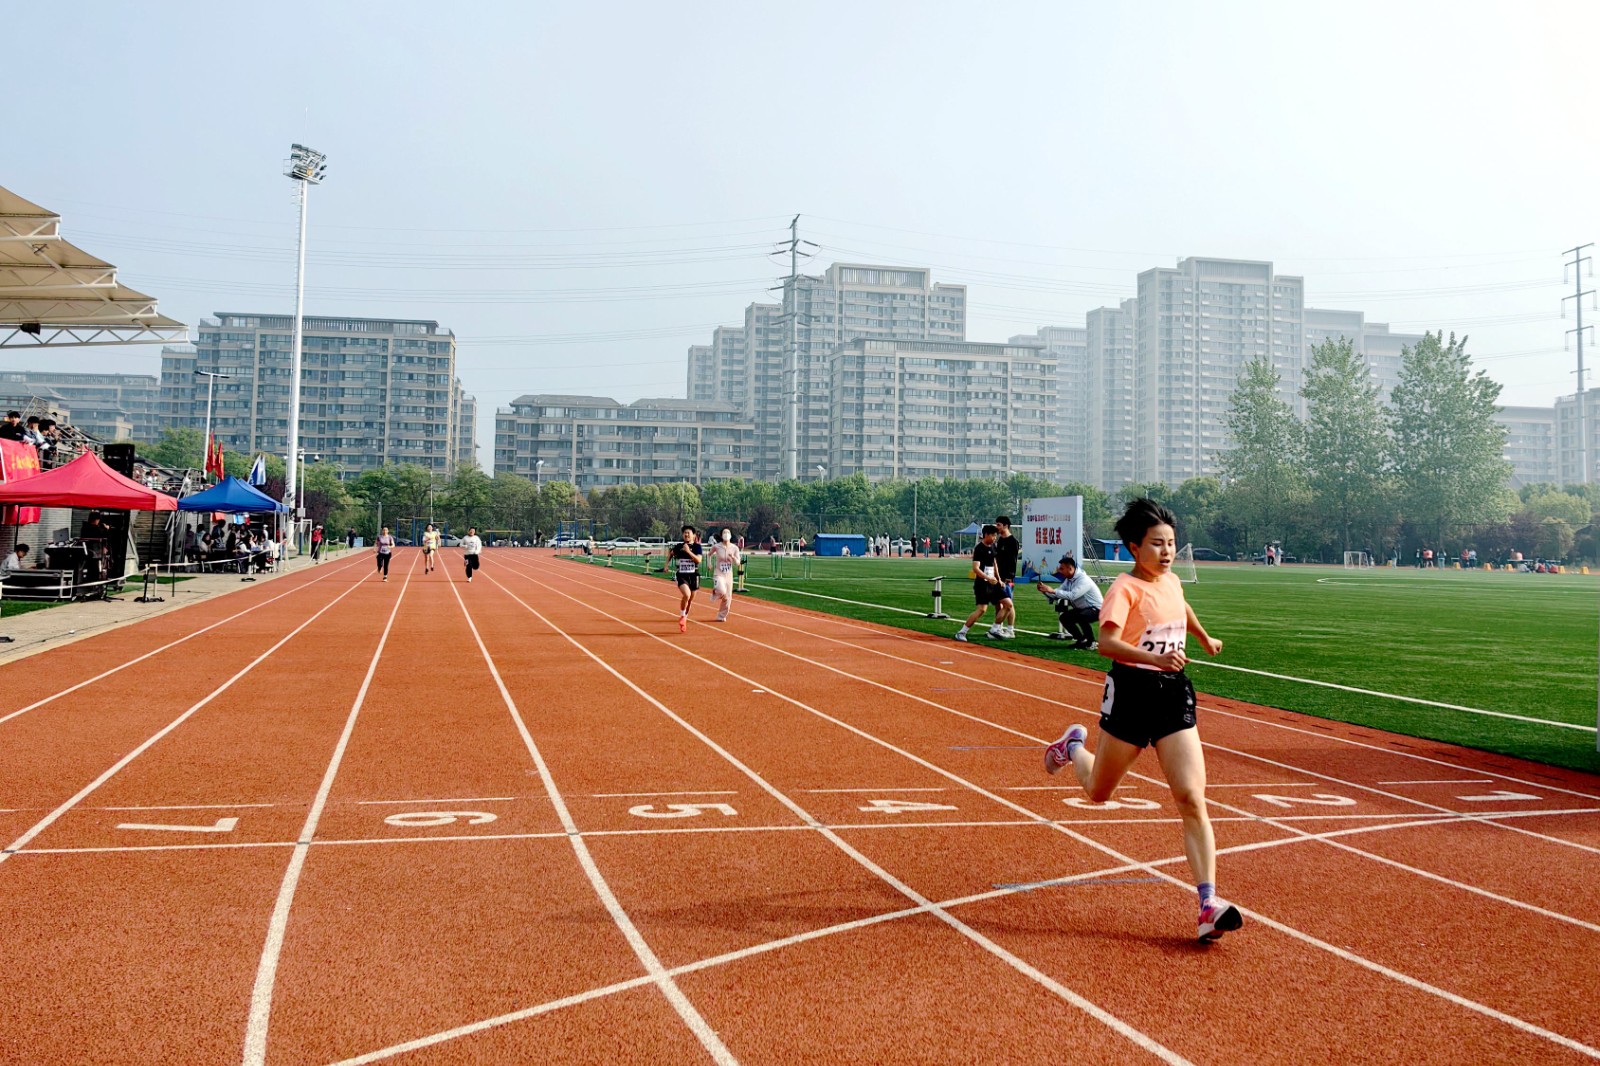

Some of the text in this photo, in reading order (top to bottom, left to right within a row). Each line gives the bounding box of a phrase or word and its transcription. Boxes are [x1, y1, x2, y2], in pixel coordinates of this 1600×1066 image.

[1062, 796, 1162, 811] 3
[1252, 793, 1357, 808] 2
[1456, 790, 1543, 802] 1
[628, 802, 738, 819] 5
[858, 799, 959, 814] 4
[115, 816, 239, 833] 7
[384, 810, 498, 828] 6
